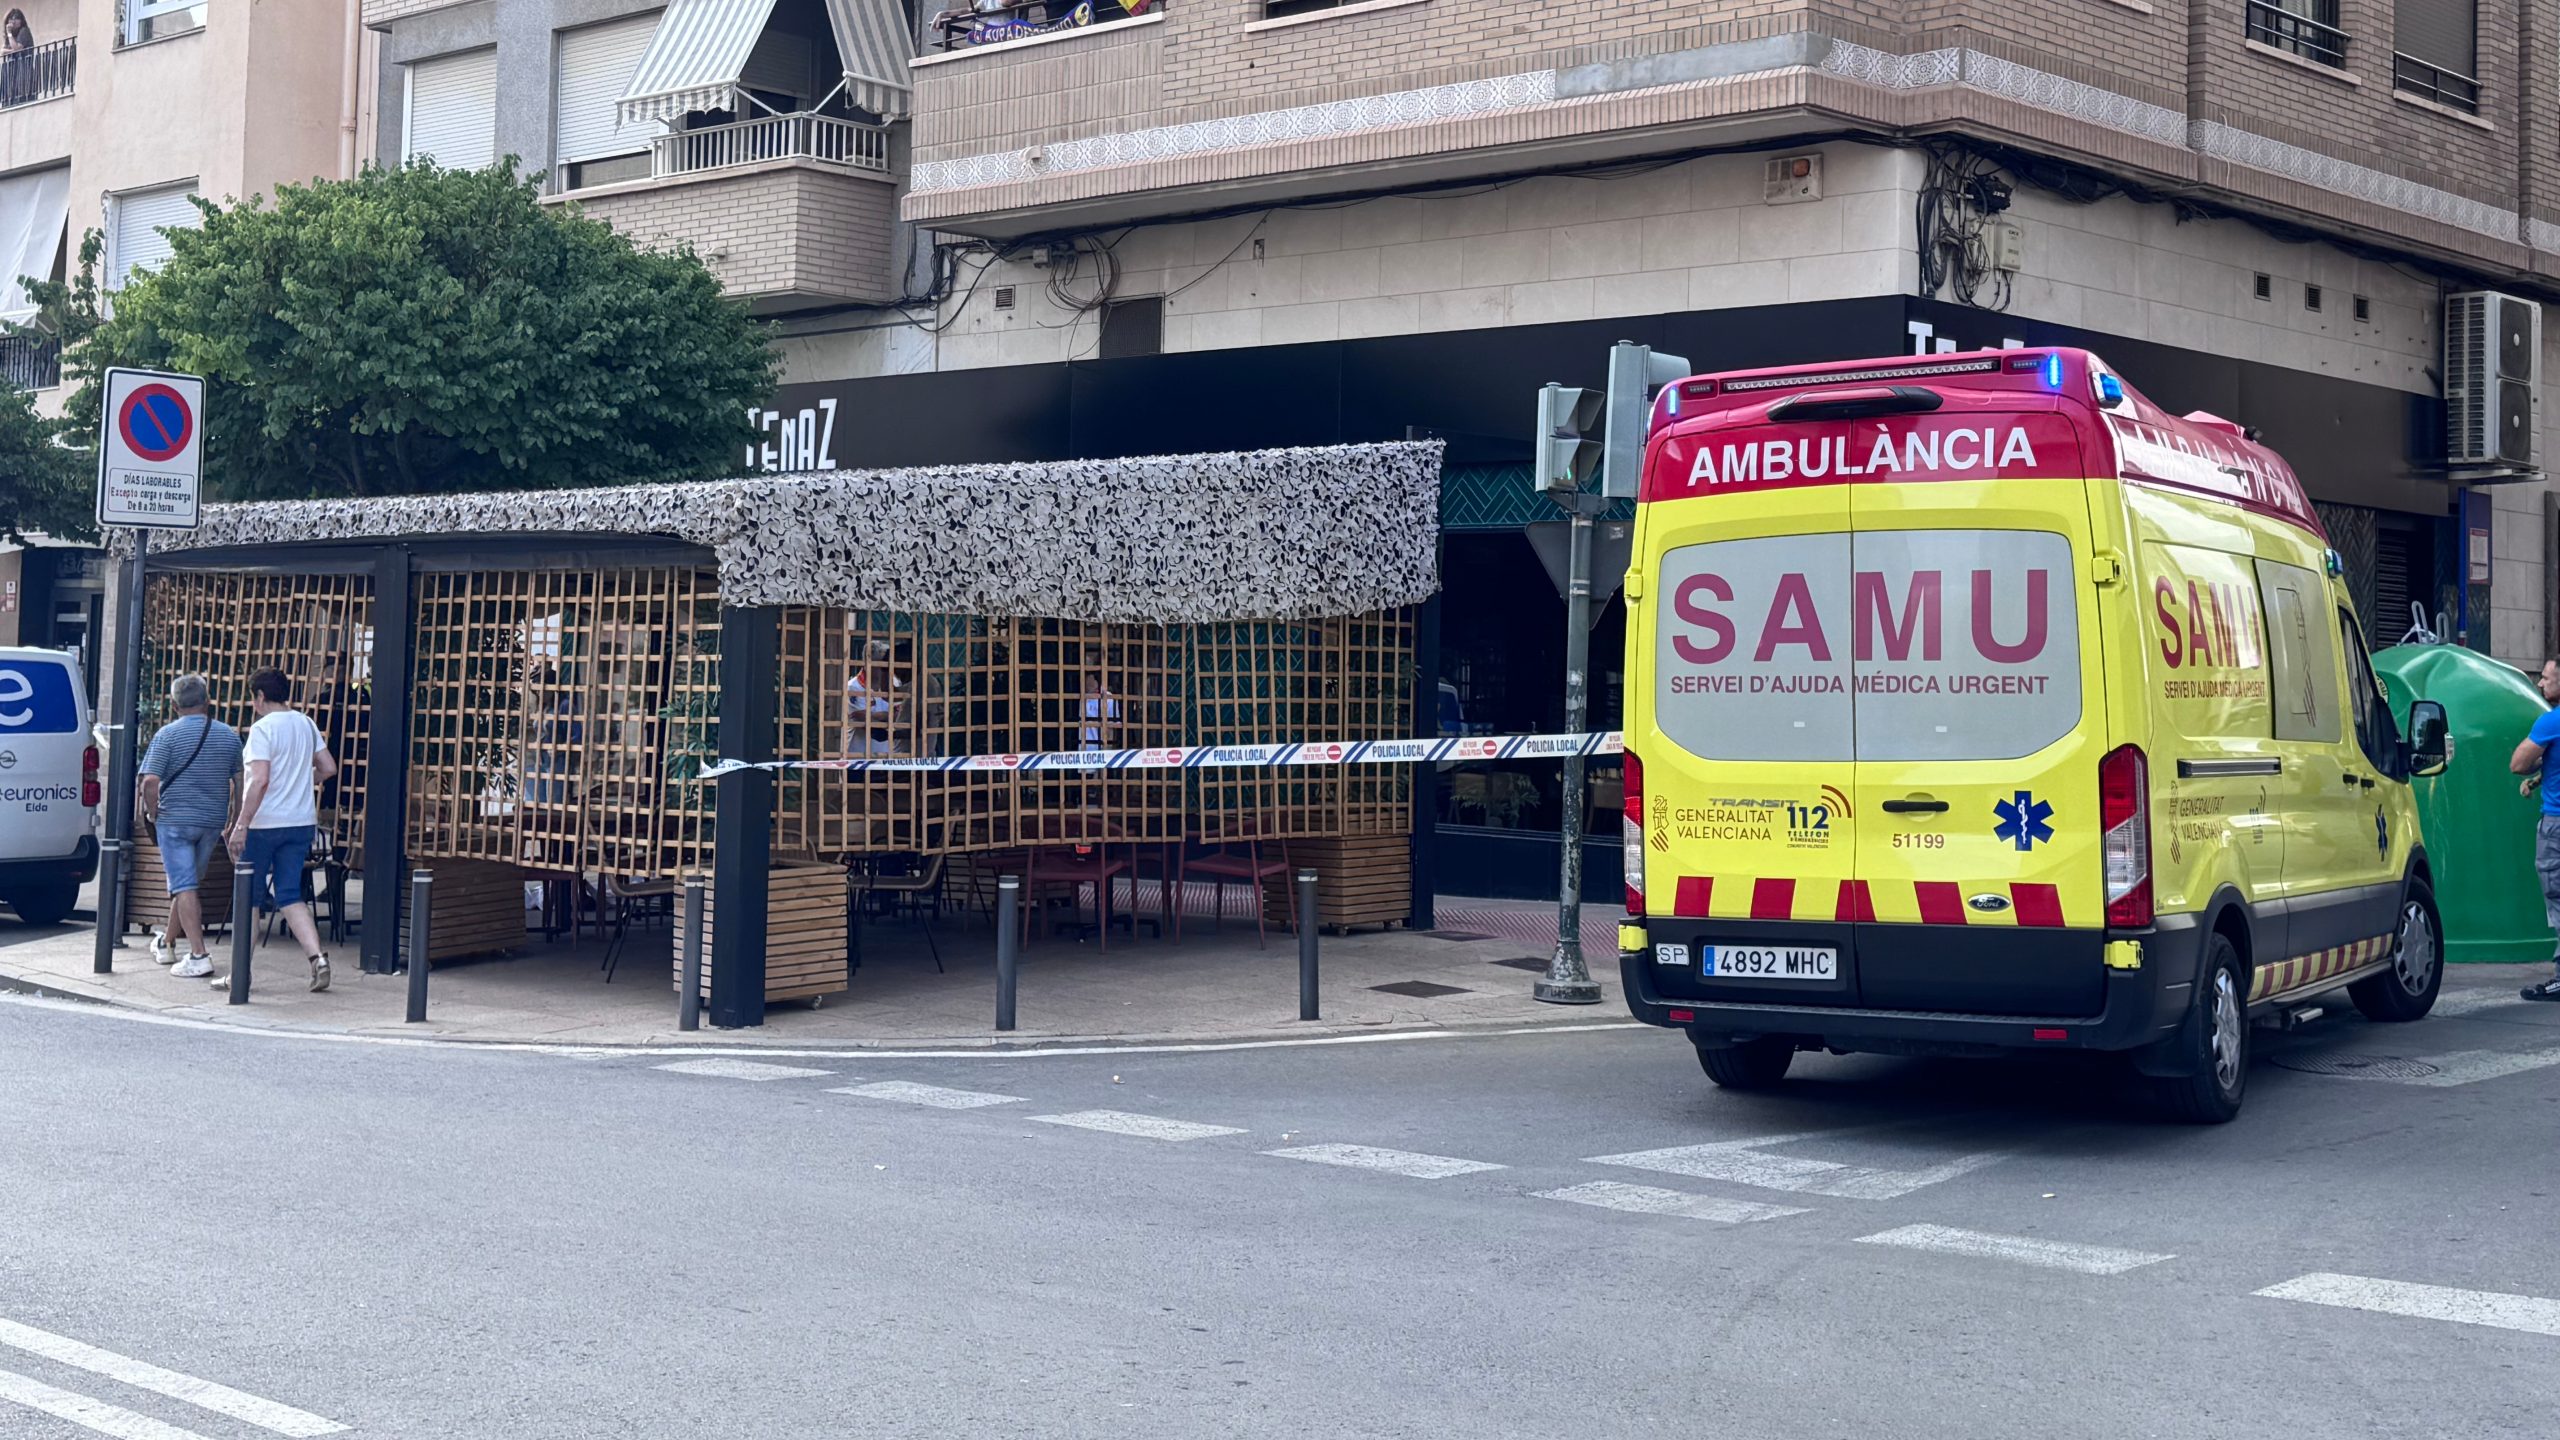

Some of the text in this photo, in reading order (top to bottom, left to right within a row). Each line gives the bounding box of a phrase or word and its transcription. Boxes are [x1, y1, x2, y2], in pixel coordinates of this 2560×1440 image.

[1687, 423, 2038, 487] AMBULÀNCIA
[124, 472, 182, 488] DÍAS LABORABLES
[111, 486, 138, 499] Excepto
[140, 489, 157, 501] carga
[164, 490, 191, 503] descarga
[127, 500, 136, 510] De
[149, 502, 156, 512] 20
[158, 503, 174, 512] horas
[1672, 569, 2049, 665] SAMU
[2155, 575, 2262, 670] SAMU
[1671, 675, 1743, 694] SERVEI
[1852, 671, 1941, 694] MÉDICA
[1948, 675, 2050, 694] URGENT
[2164, 680, 2190, 699] SERVEI
[1372, 744, 1425, 758] POLICIA LOCAL
[1526, 739, 1579, 753] POLICIA LOCAL
[1050, 752, 1107, 765] POLICIA LOCAL
[1213, 748, 1268, 762] POLICIA LOCAL
[4, 783, 77, 801] euronics
[26, 802, 48, 812] Elda
[1708, 798, 1800, 808] TRANSIT
[2180, 796, 2225, 817] GENERALITAT
[1675, 808, 1774, 823] GENERALITAT
[1787, 805, 1829, 829] 112
[1677, 826, 1772, 841] VALENCIANA
[1892, 832, 1945, 849] 51199
[1659, 947, 1685, 962] SP
[1720, 950, 1829, 975] 4892 MHC
